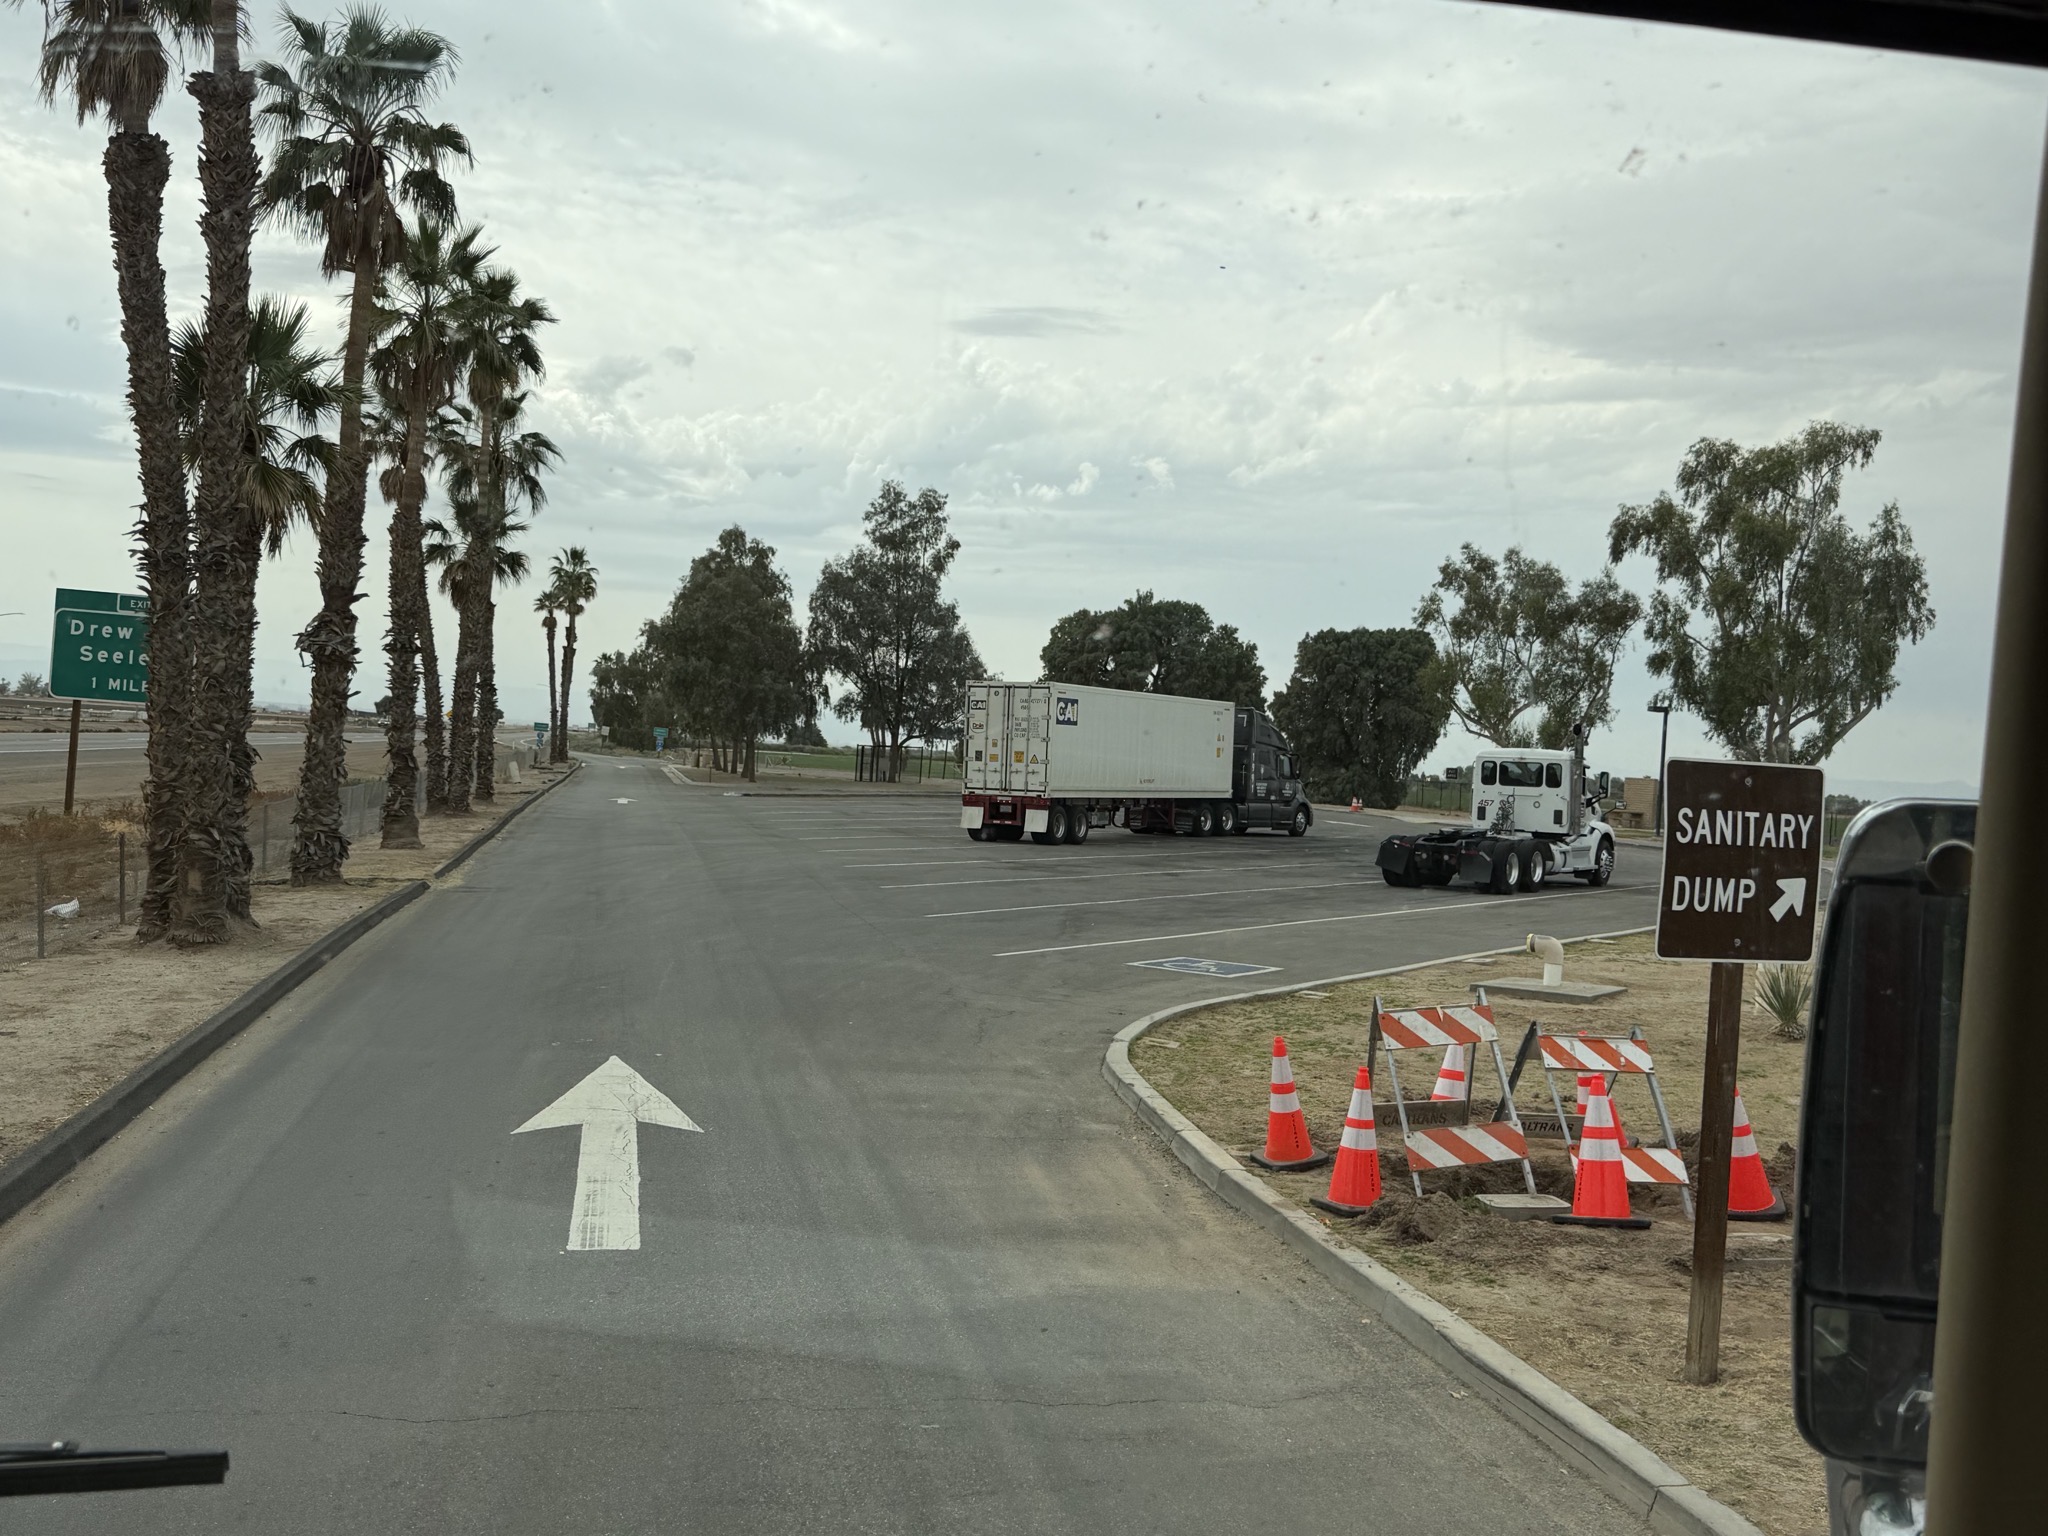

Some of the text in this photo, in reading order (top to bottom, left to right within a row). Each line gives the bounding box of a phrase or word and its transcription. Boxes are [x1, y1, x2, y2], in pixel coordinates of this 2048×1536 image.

[70, 619, 133, 640] Drew
[91, 676, 149, 692] 1 MILE
[971, 701, 986, 709] CAI
[1057, 701, 1078, 722] CAI
[1478, 799, 1495, 807] 457
[1675, 807, 1814, 849] SANITARY
[1671, 875, 1756, 913] DUMP
[1521, 1121, 1574, 1132] ALTRANS
